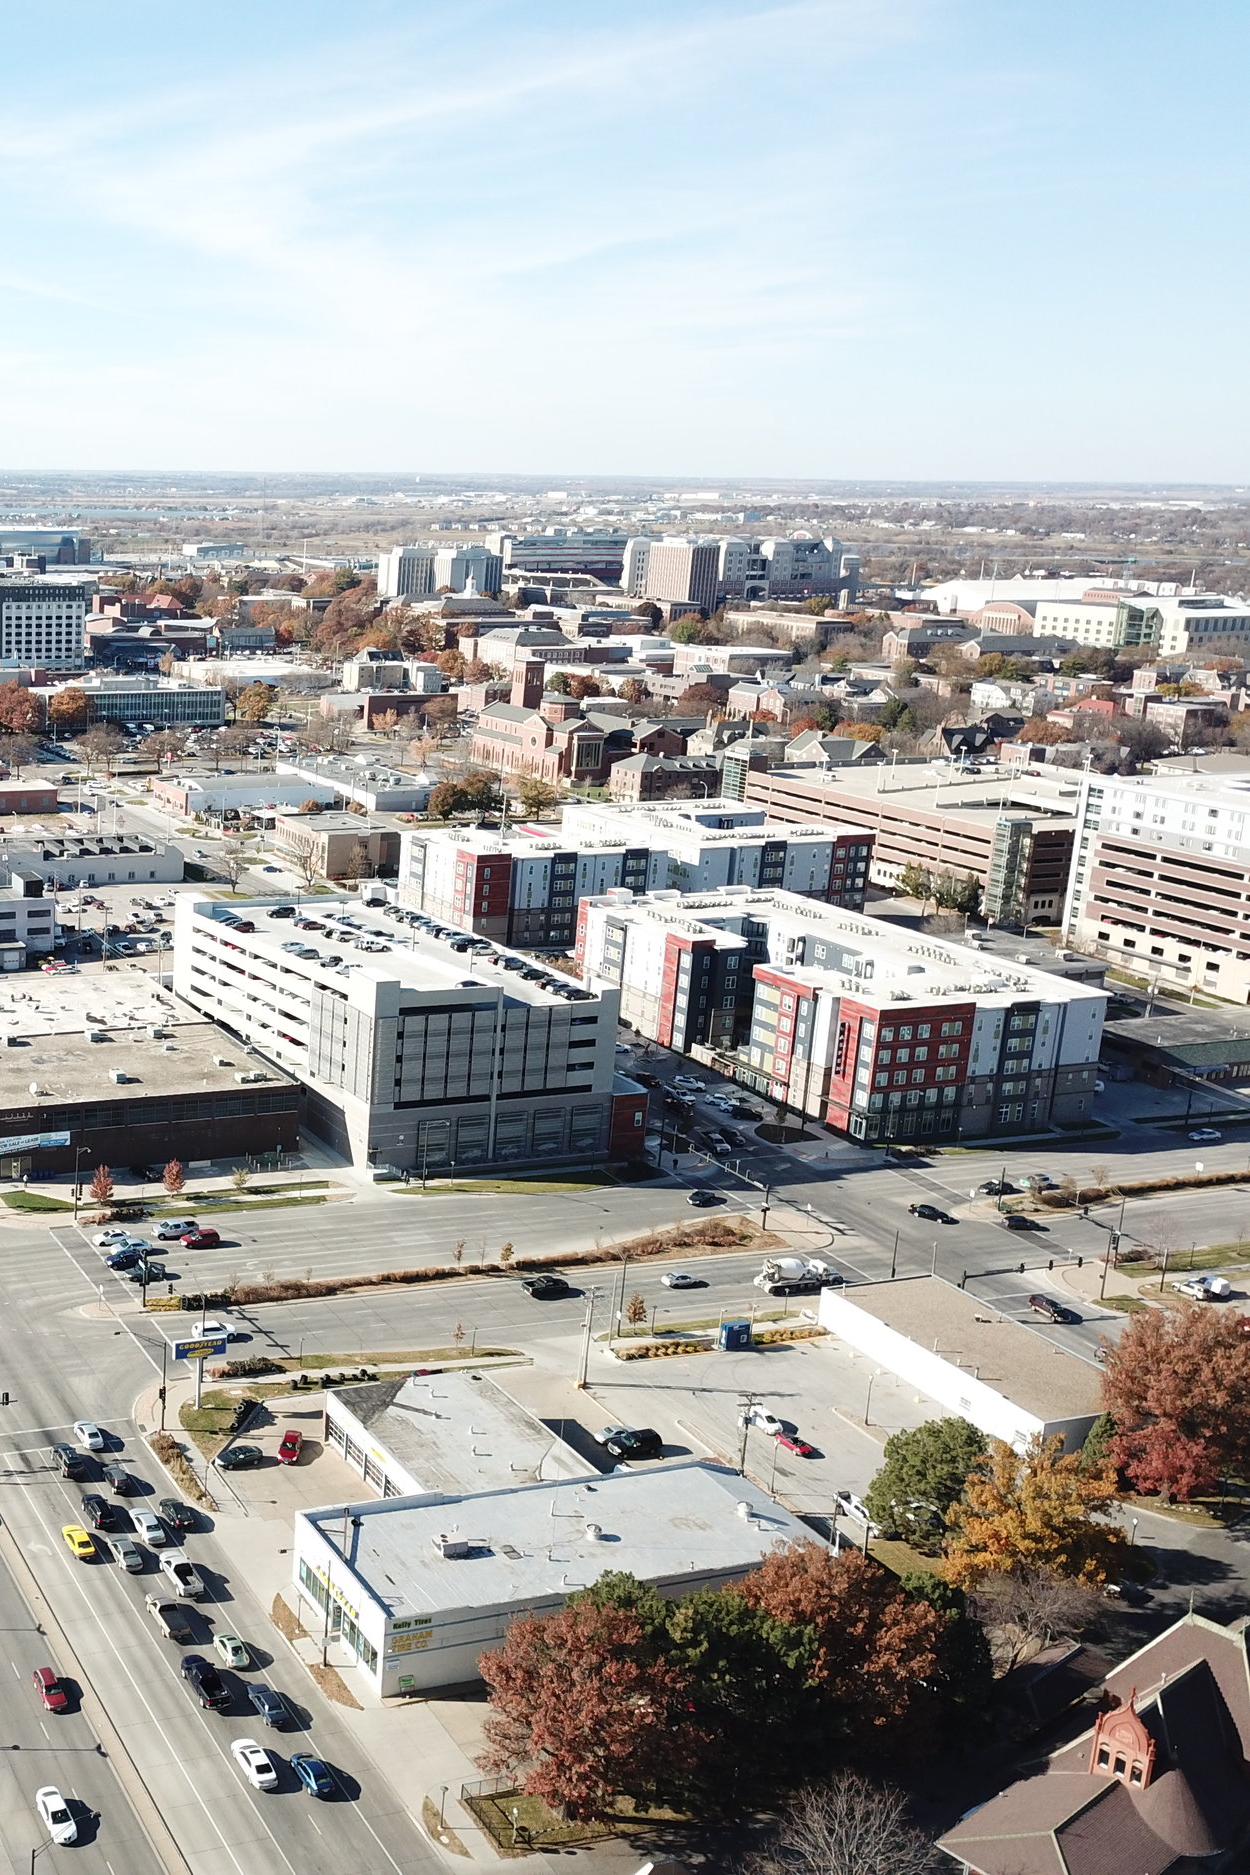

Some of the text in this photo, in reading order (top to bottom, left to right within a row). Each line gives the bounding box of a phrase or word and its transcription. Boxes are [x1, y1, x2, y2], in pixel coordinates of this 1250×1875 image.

[179, 1340, 222, 1350] GOODYEAR
[393, 1618, 432, 1630] Kelly Tires
[392, 1630, 434, 1645] GRAHAM
[392, 1642, 412, 1653] TIRE
